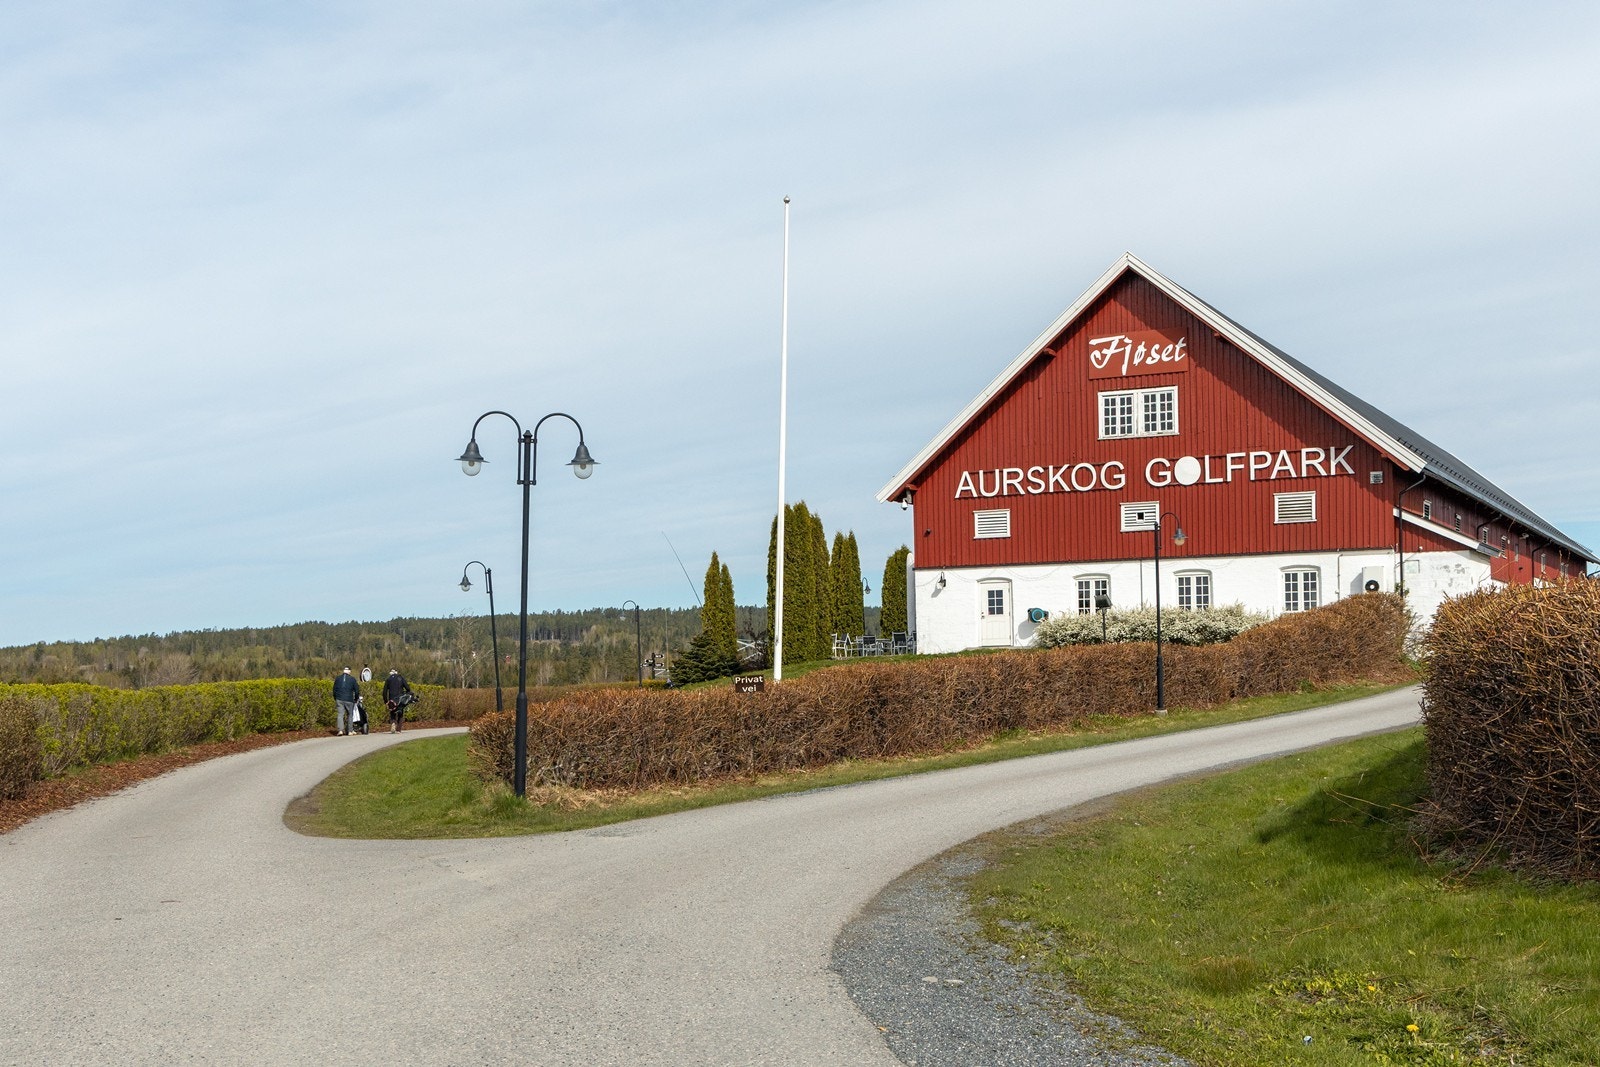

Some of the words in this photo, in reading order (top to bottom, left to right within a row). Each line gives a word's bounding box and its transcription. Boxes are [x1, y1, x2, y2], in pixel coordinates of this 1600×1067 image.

[1088, 334, 1187, 376] Fjøset
[954, 460, 1126, 499] AURSKOG
[1145, 445, 1355, 487] GOLFPARK
[735, 676, 763, 684] Privat
